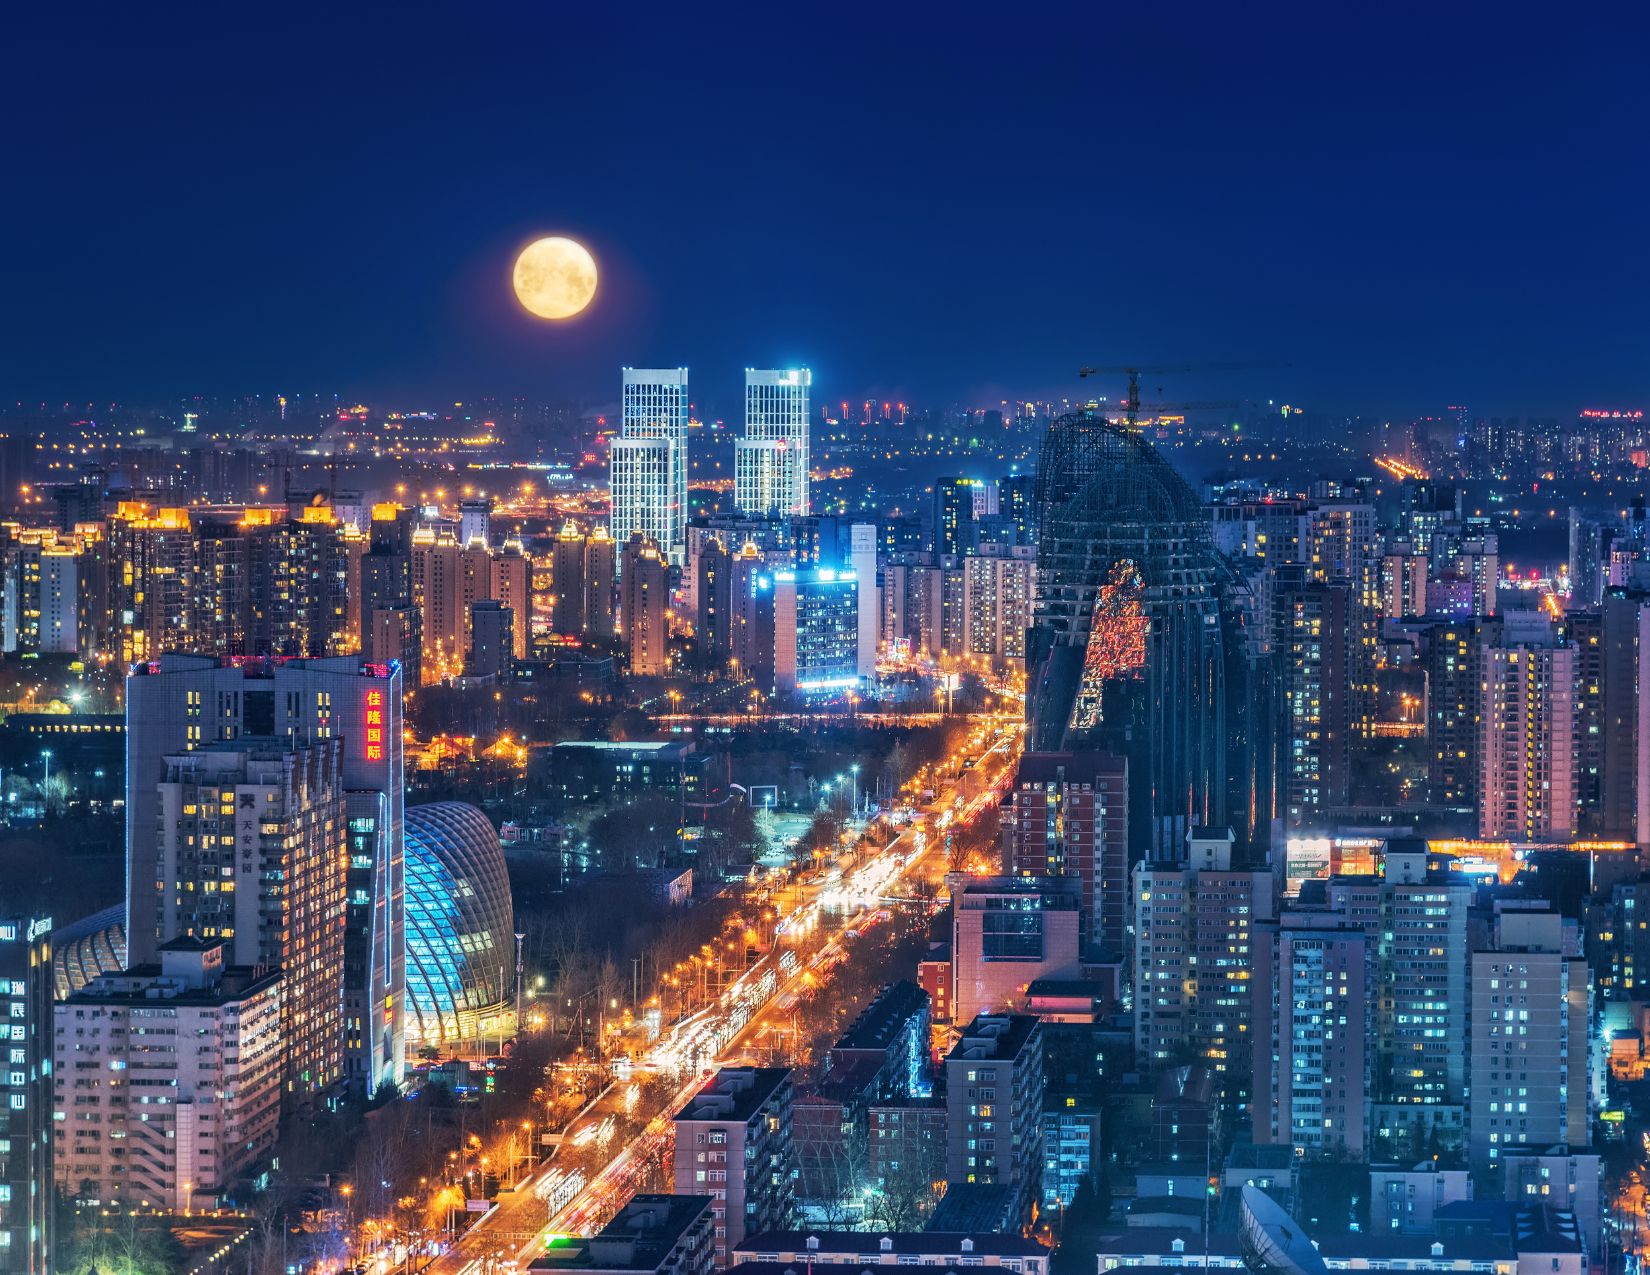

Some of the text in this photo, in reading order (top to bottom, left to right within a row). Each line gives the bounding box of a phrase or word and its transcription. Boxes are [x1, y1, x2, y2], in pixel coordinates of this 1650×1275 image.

[367, 691, 381, 759] 佳隆国际
[10, 981, 25, 1109] 瑞辰国际中心
